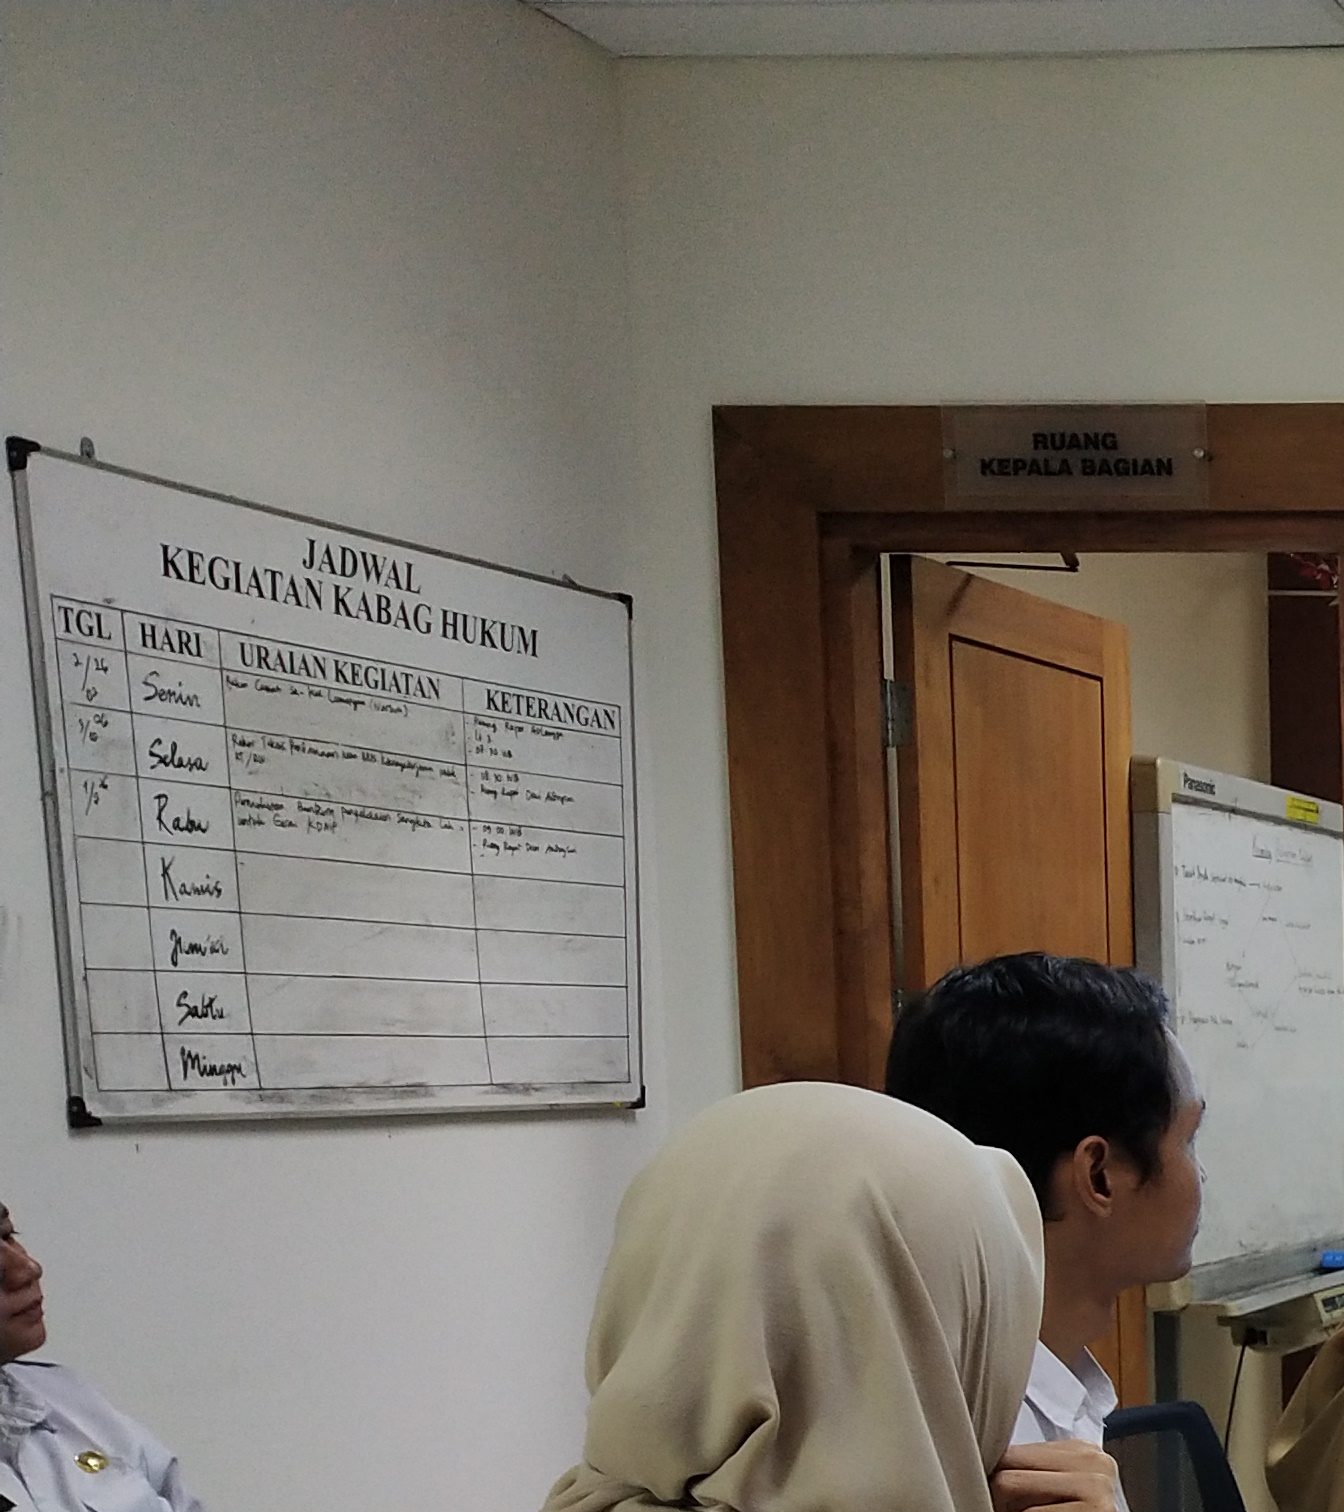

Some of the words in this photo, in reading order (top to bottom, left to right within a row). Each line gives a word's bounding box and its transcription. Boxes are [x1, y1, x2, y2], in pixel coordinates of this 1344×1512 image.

[1032, 432, 1119, 450] RUANG
[980, 458, 1073, 477] KEPALA
[1081, 458, 1173, 476] BAGIAN
[302, 538, 422, 594] JADWAL
[160, 542, 323, 611] KEGIATAN
[333, 584, 432, 634] KABAG
[441, 607, 539, 658] HUKUM
[58, 606, 112, 640] TGL
[139, 622, 203, 658] HARI
[142, 671, 201, 708] Senin
[240, 642, 327, 680] URAIAN
[334, 660, 440, 700] KEGIATAN
[485, 688, 617, 731] KETERANGAN
[148, 738, 208, 772] Selasa
[154, 794, 210, 836] Rabu
[161, 856, 222, 901] Kamis
[175, 990, 225, 1026] Sabtu
[180, 1045, 246, 1086] Minggu
